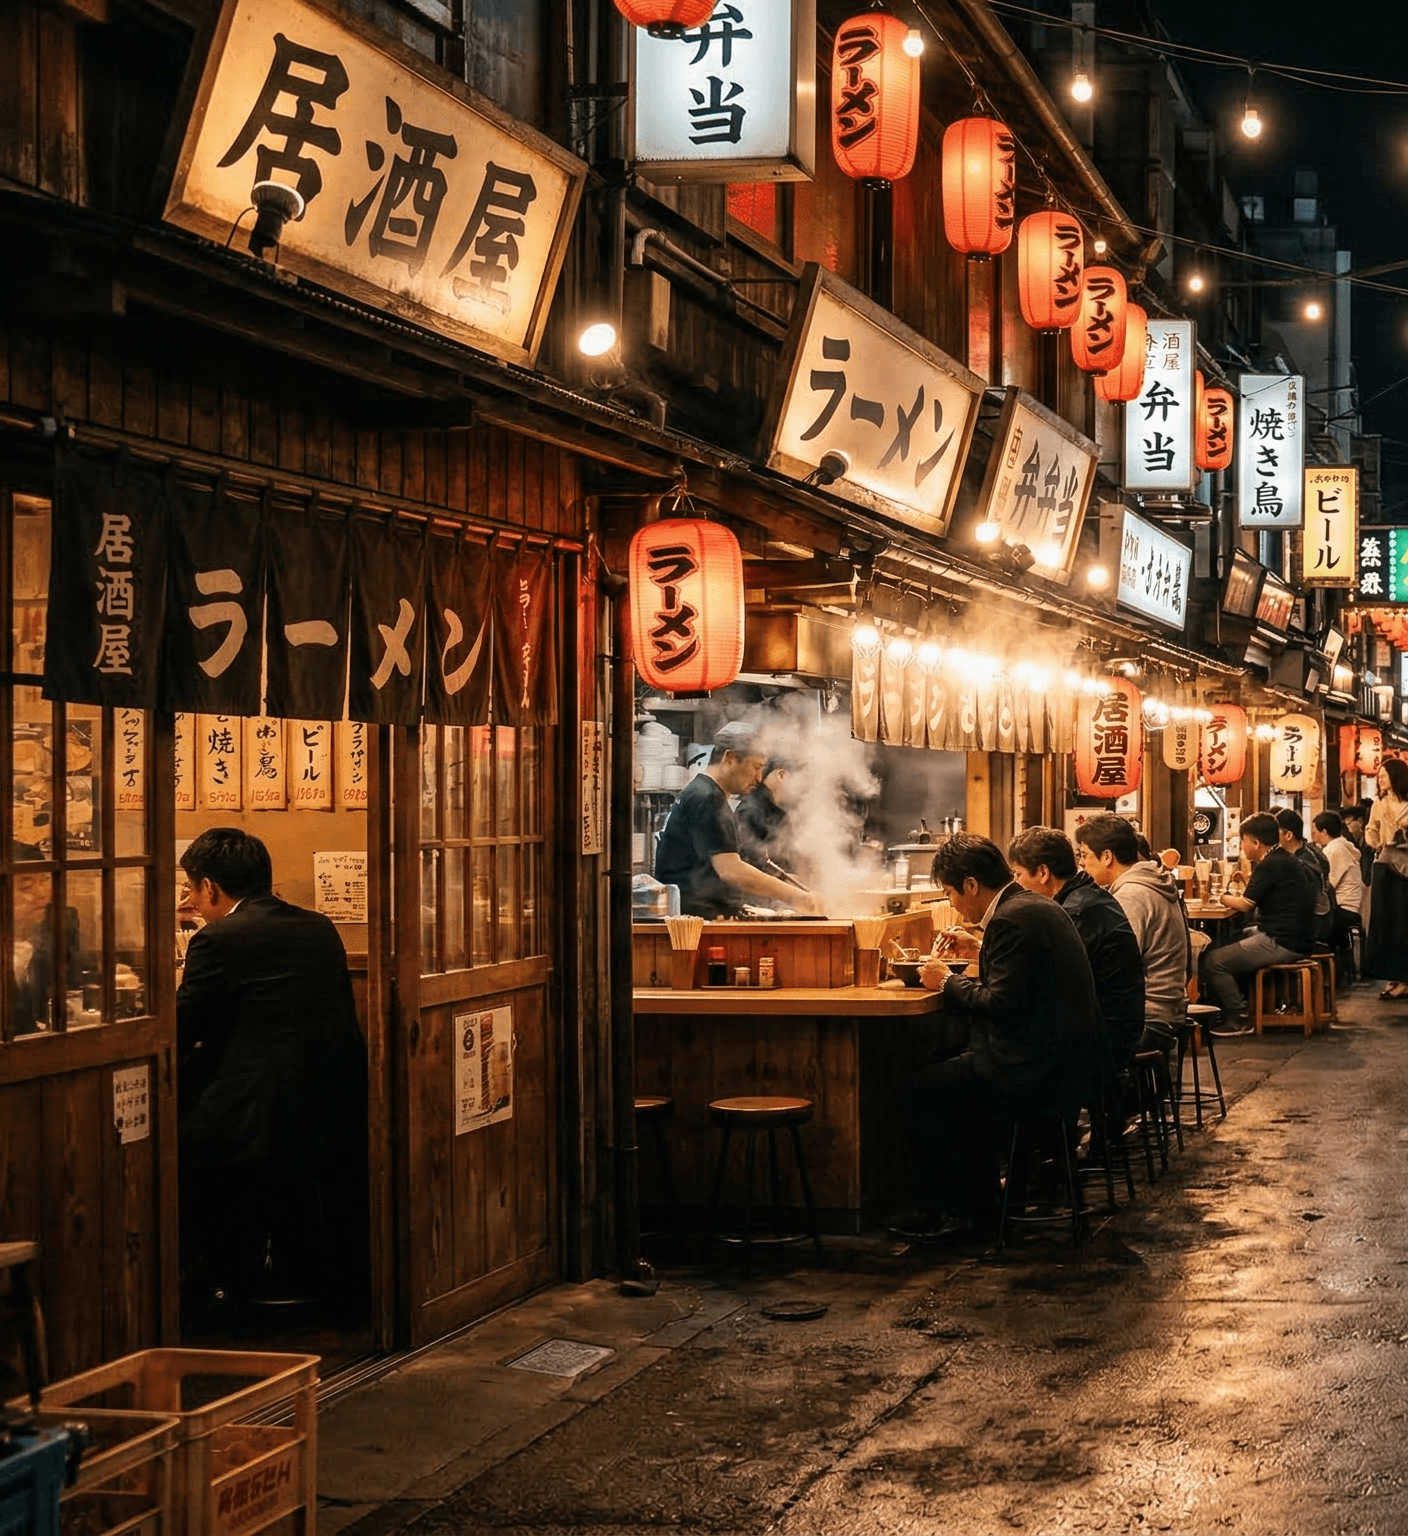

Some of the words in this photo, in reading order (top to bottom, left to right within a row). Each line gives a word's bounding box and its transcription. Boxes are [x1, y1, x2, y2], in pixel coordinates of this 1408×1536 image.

[680, 3, 753, 146] 弁当
[838, 27, 880, 148] ラーメン
[217, 32, 537, 313] 居酒屋
[1054, 225, 1081, 308] ラーメン
[1087, 278, 1115, 354] ラーメン
[800, 336, 956, 488] ラーメン
[1140, 381, 1180, 472] 弁当
[1206, 398, 1227, 457] ラーメン
[1250, 407, 1285, 518] 焼き鳥
[1314, 488, 1341, 569] ビール
[93, 511, 135, 676] 居酒屋
[188, 568, 490, 696] ラーメン
[646, 544, 699, 673] ラーメン
[1092, 691, 1129, 787] 居酒屋
[1206, 716, 1228, 776] ラーメン
